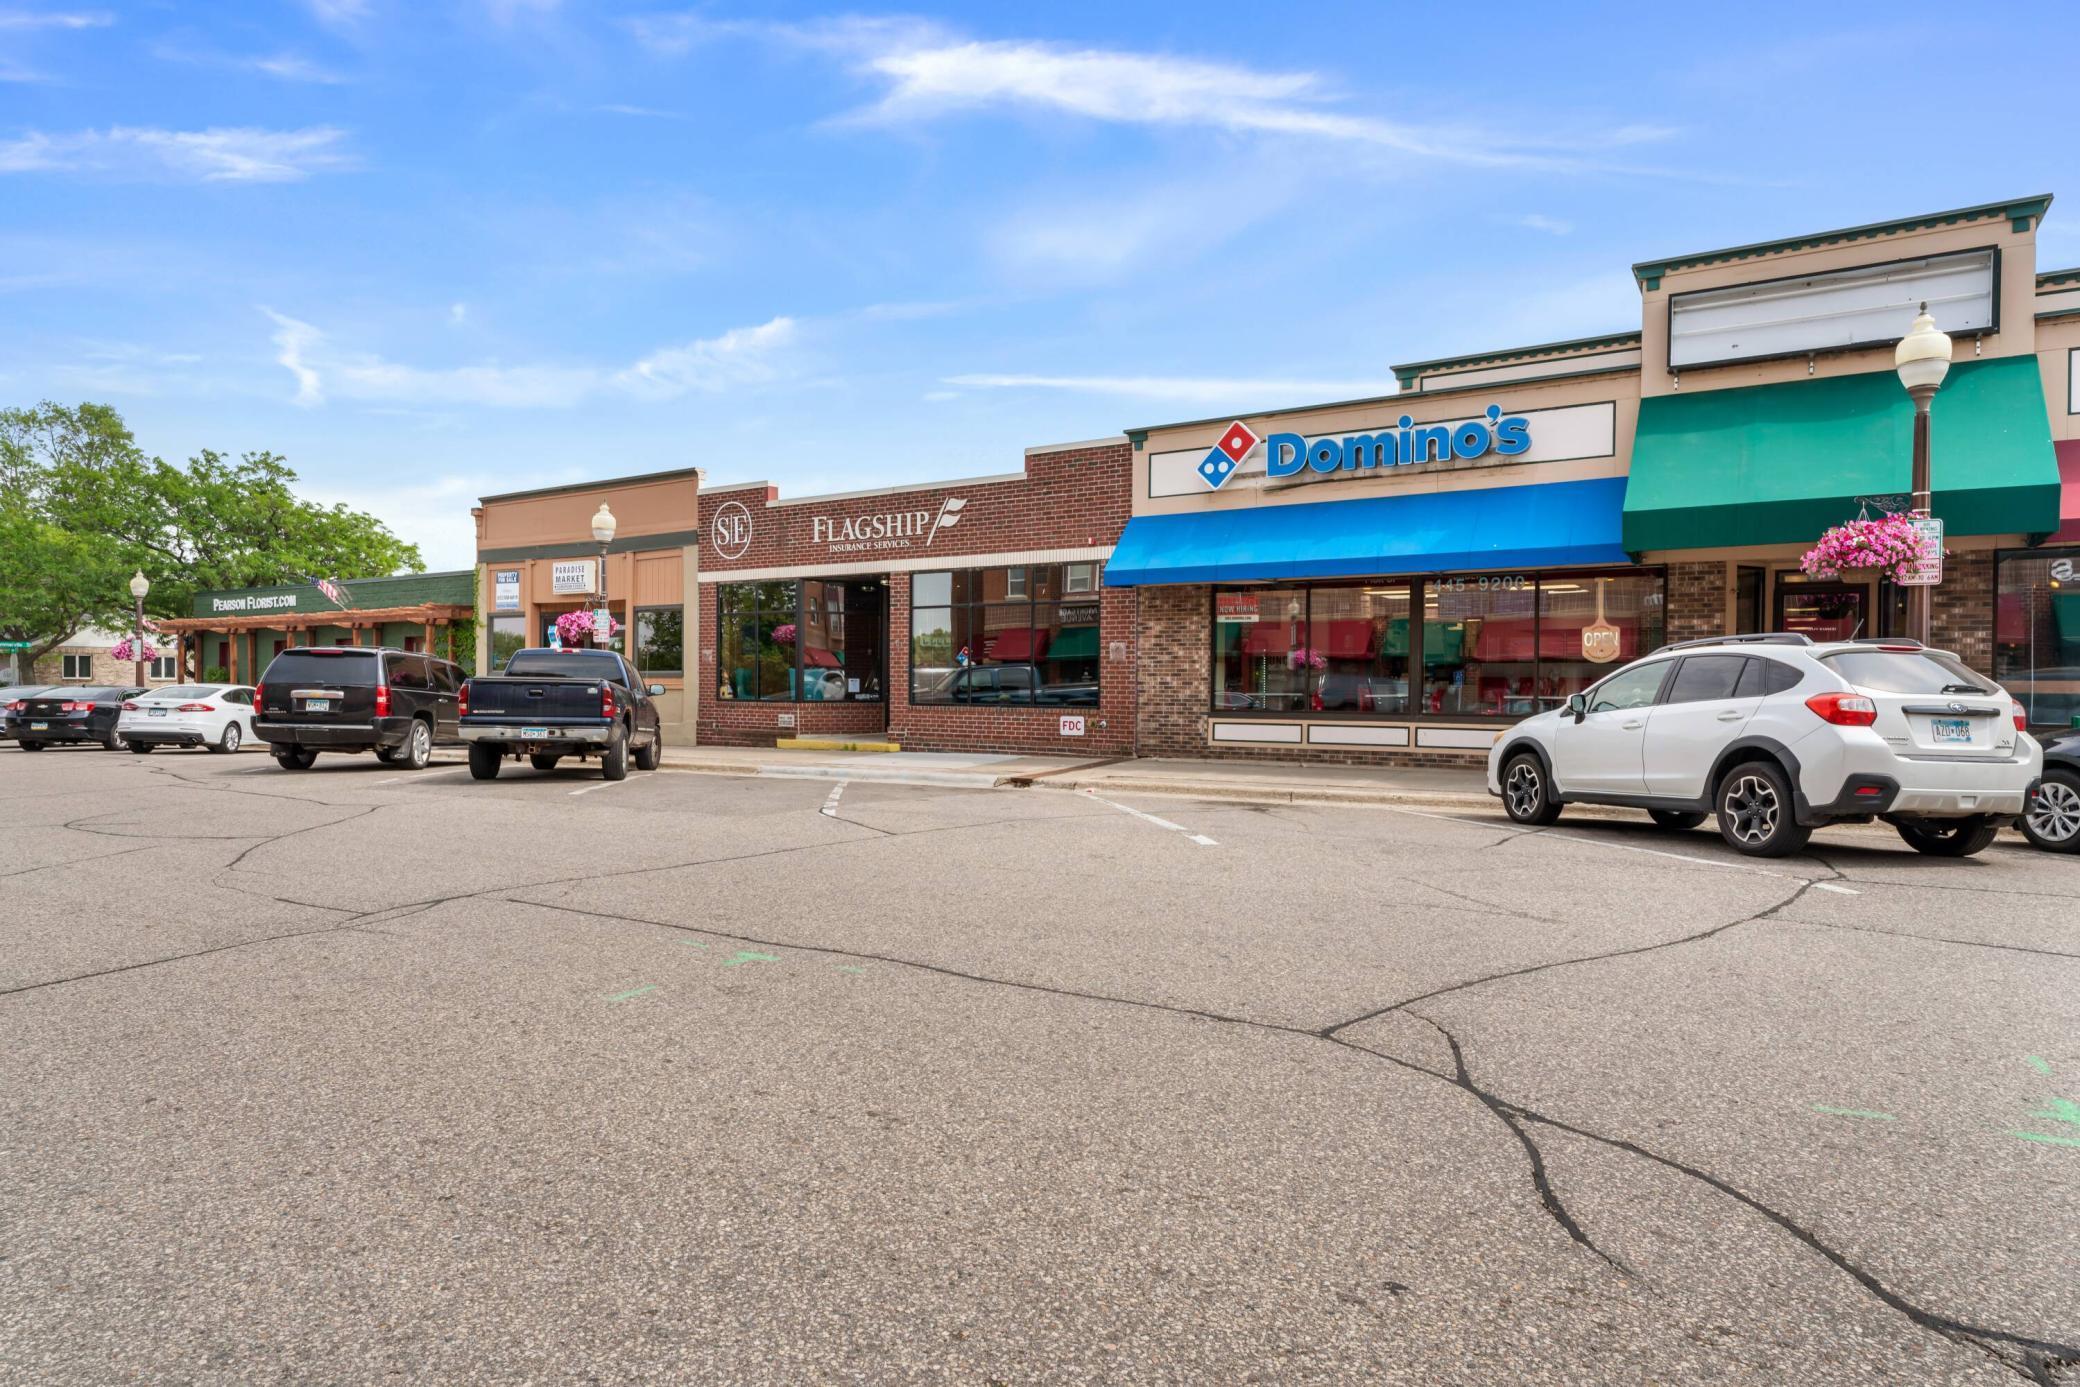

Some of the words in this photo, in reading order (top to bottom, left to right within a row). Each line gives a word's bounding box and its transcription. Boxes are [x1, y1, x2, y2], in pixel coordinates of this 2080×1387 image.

[1264, 403, 1533, 478] Domino's
[811, 511, 930, 543] FLAGSHIP
[829, 541, 871, 553] INSURANCE
[873, 539, 910, 550] SERVICES
[555, 565, 585, 574] PARADISE
[555, 574, 585, 583] MARKET
[1478, 575, 1525, 592] 9200
[1219, 605, 1235, 613] NOW
[1236, 604, 1258, 613] HIRING
[1584, 631, 1618, 647] OPEN
[1062, 720, 1082, 731] FDC
